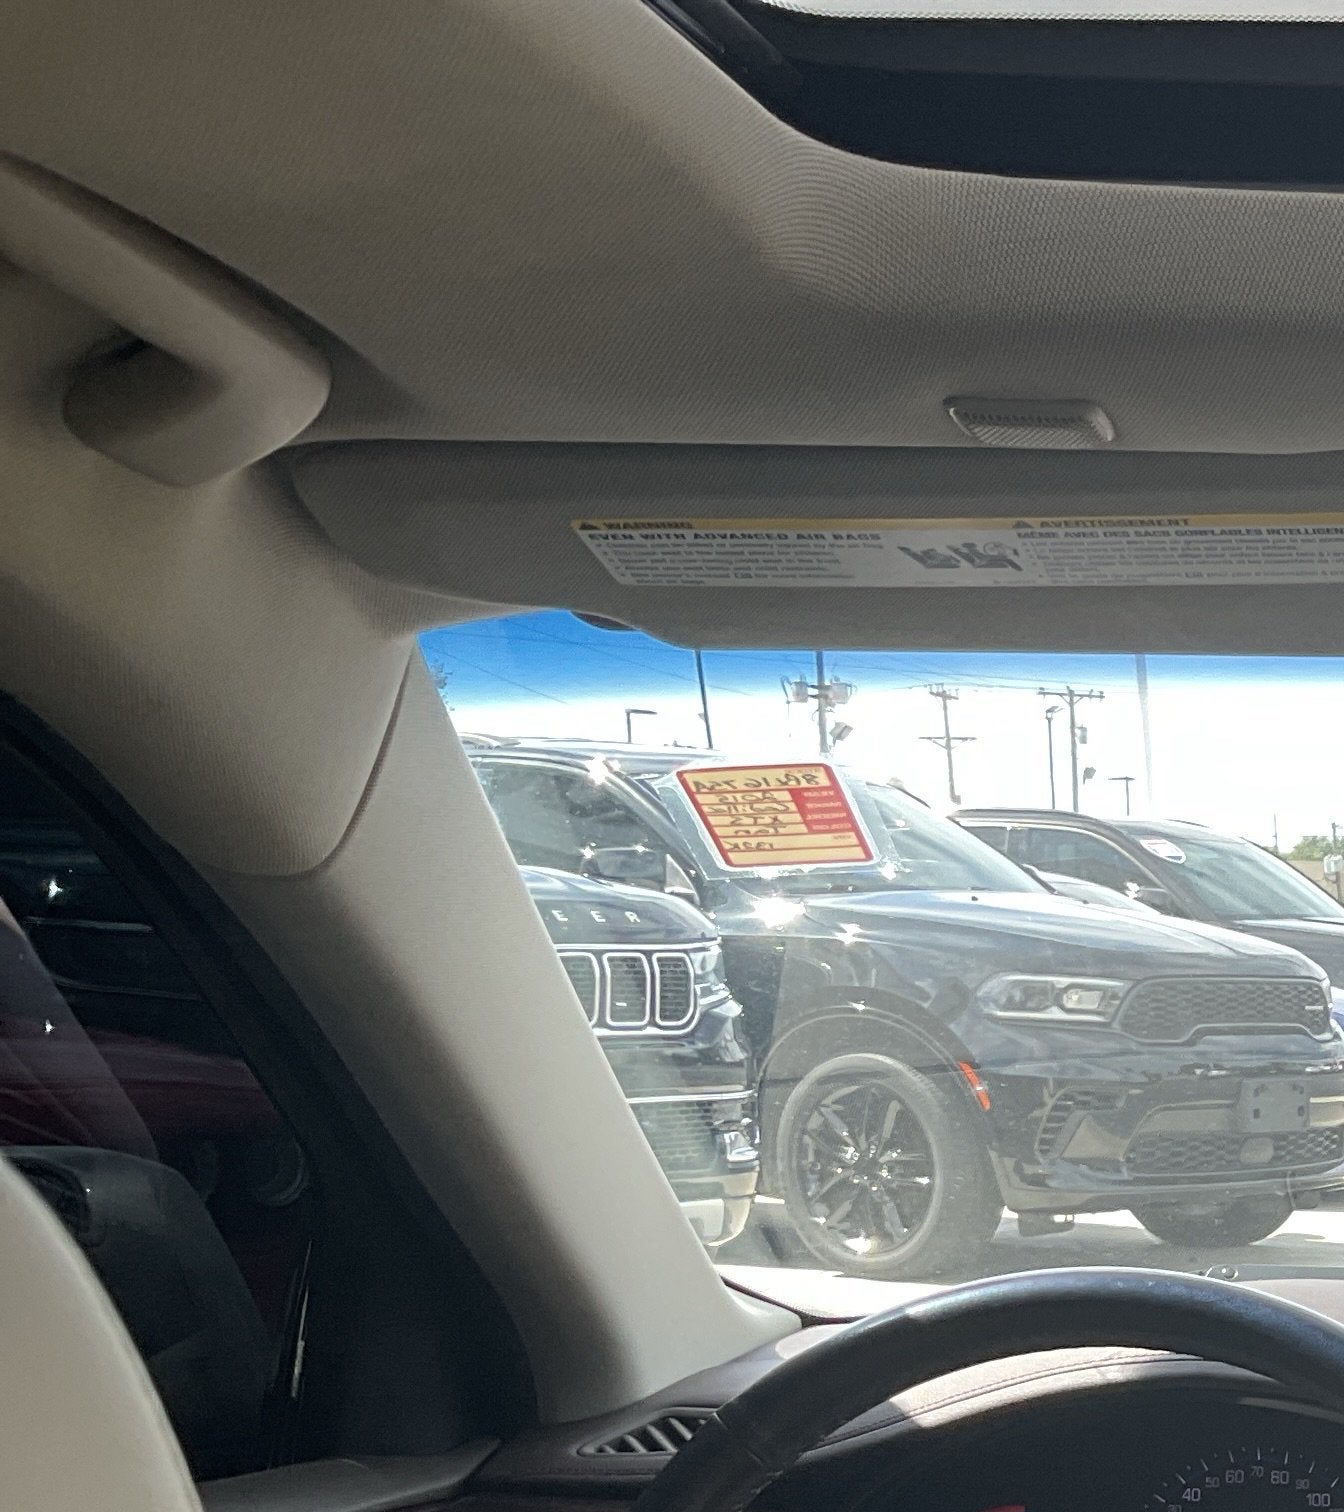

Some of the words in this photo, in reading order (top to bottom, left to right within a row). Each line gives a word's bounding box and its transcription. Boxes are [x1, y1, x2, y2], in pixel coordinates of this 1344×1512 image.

[639, 532, 687, 541] WITH
[693, 532, 789, 541] ADVANCED
[796, 532, 826, 541] AIR
[1225, 1469, 1245, 1484] 60
[1250, 1465, 1264, 1478] 70
[1270, 1470, 1290, 1485] 80
[1205, 1476, 1220, 1488] 50
[1181, 1487, 1201, 1502] 40
[1305, 1493, 1331, 1507] 100
